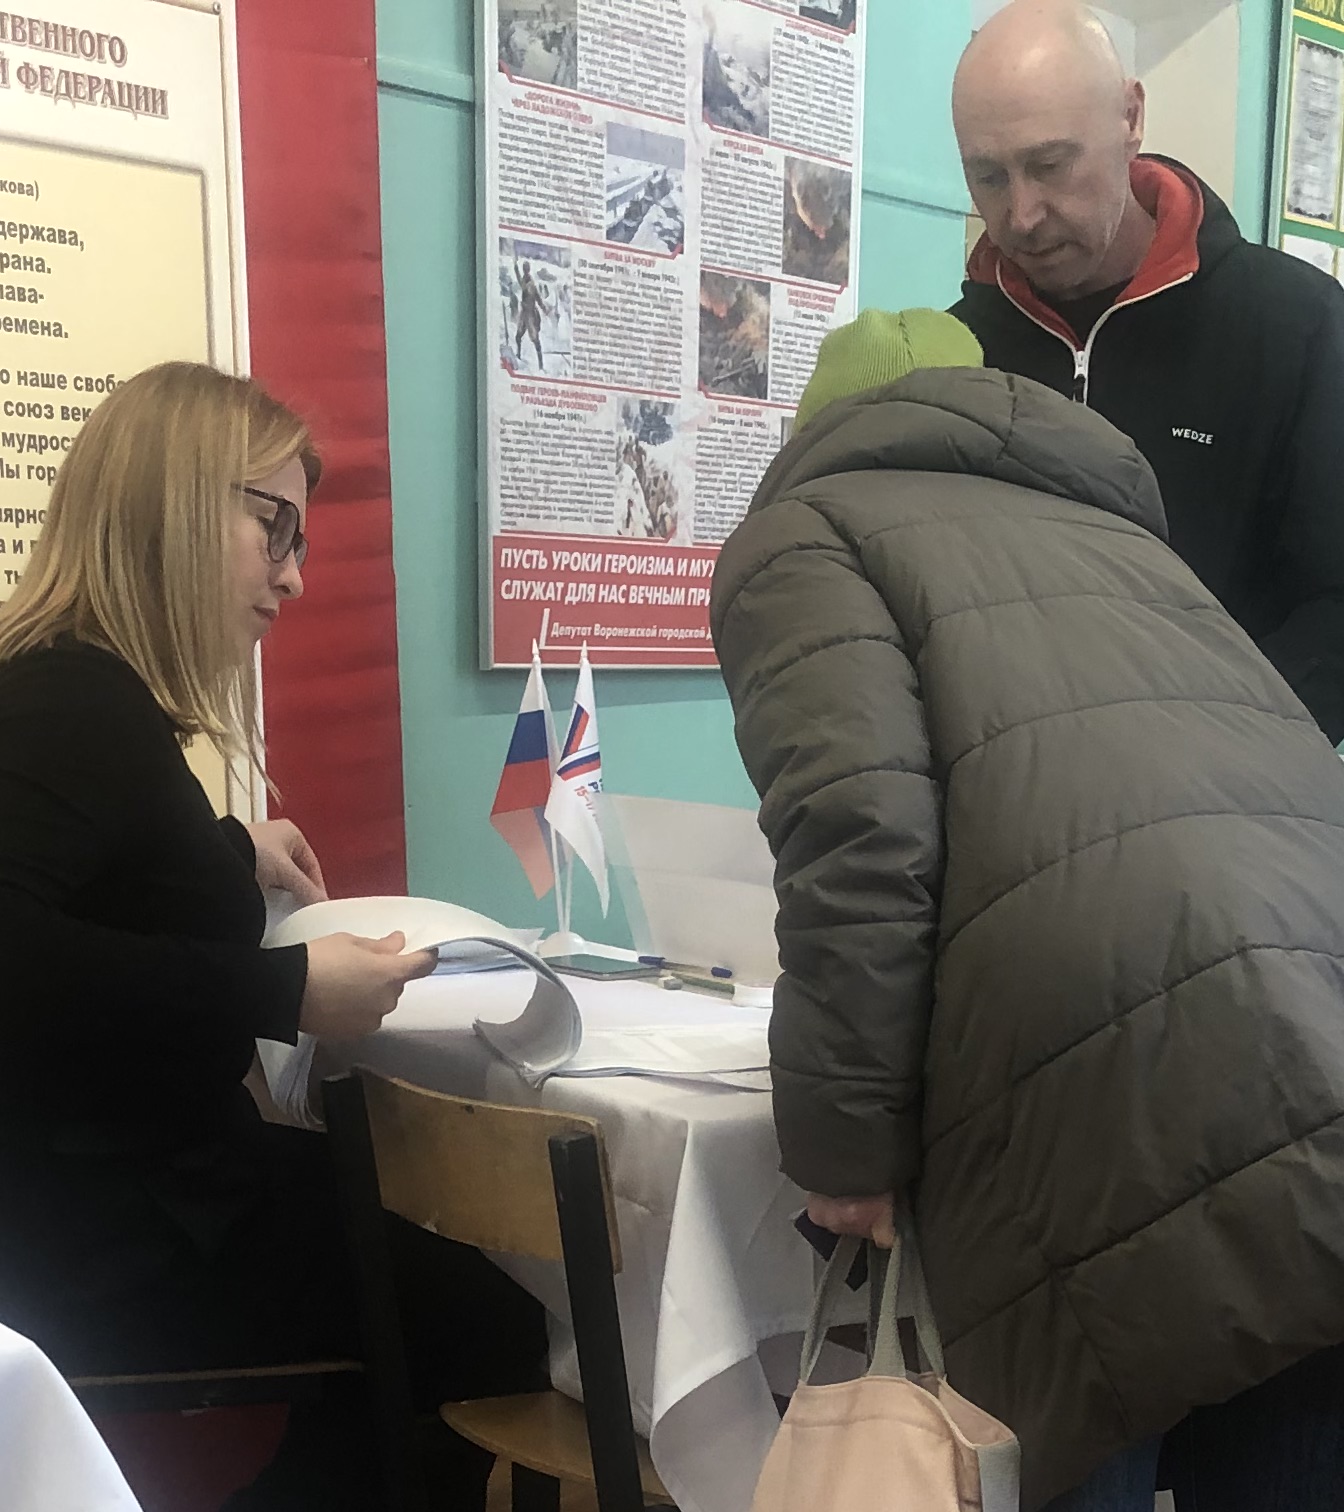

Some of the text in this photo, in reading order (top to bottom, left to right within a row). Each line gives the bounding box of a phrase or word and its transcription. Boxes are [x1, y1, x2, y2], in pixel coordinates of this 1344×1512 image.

[17, 62, 169, 119] ФЕДЕРАЦИИ
[17, 370, 68, 391] наше
[4, 400, 55, 421] союз
[1171, 427, 1214, 445] WEDZE
[12, 538, 24, 554] и
[500, 548, 548, 570] ПУСТЬ
[552, 551, 602, 573] УРОКИ
[604, 554, 674, 576] ГЕРОИЗМА
[676, 557, 687, 577] И
[501, 579, 564, 601] СЛУЖАТ
[564, 582, 596, 605] ДЛЯ
[598, 584, 626, 604] НАС
[629, 585, 686, 606] ВЕЧНЫМ
[551, 622, 592, 639] Депутат
[594, 623, 657, 640] Воронежской
